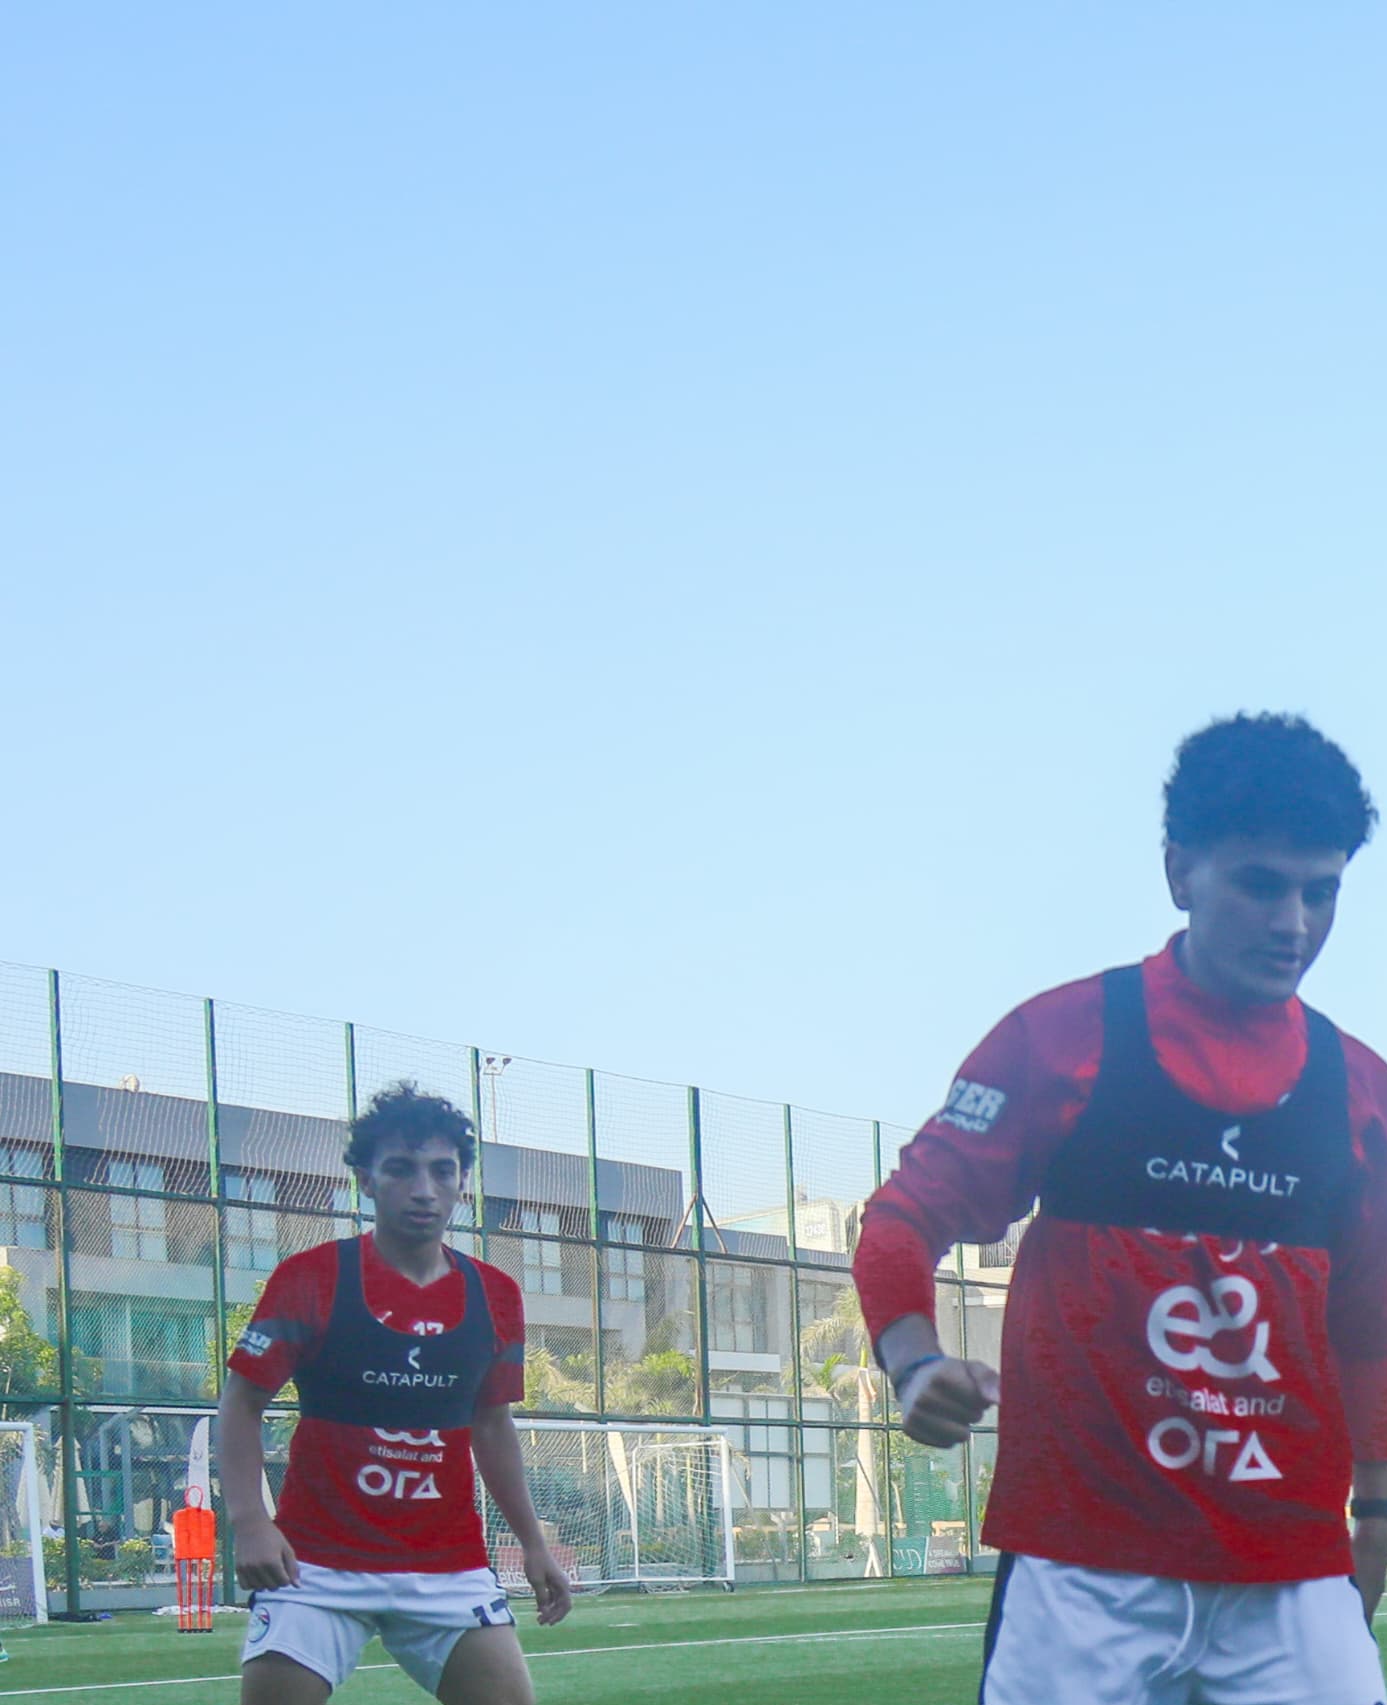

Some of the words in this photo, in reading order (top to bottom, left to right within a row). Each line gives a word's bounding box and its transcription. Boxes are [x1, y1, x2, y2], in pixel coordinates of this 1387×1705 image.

[1146, 1157, 1300, 1196] CATAPULT
[362, 1370, 459, 1388] CATAPULT
[1234, 1395, 1286, 1416] and
[421, 1451, 443, 1463] and
